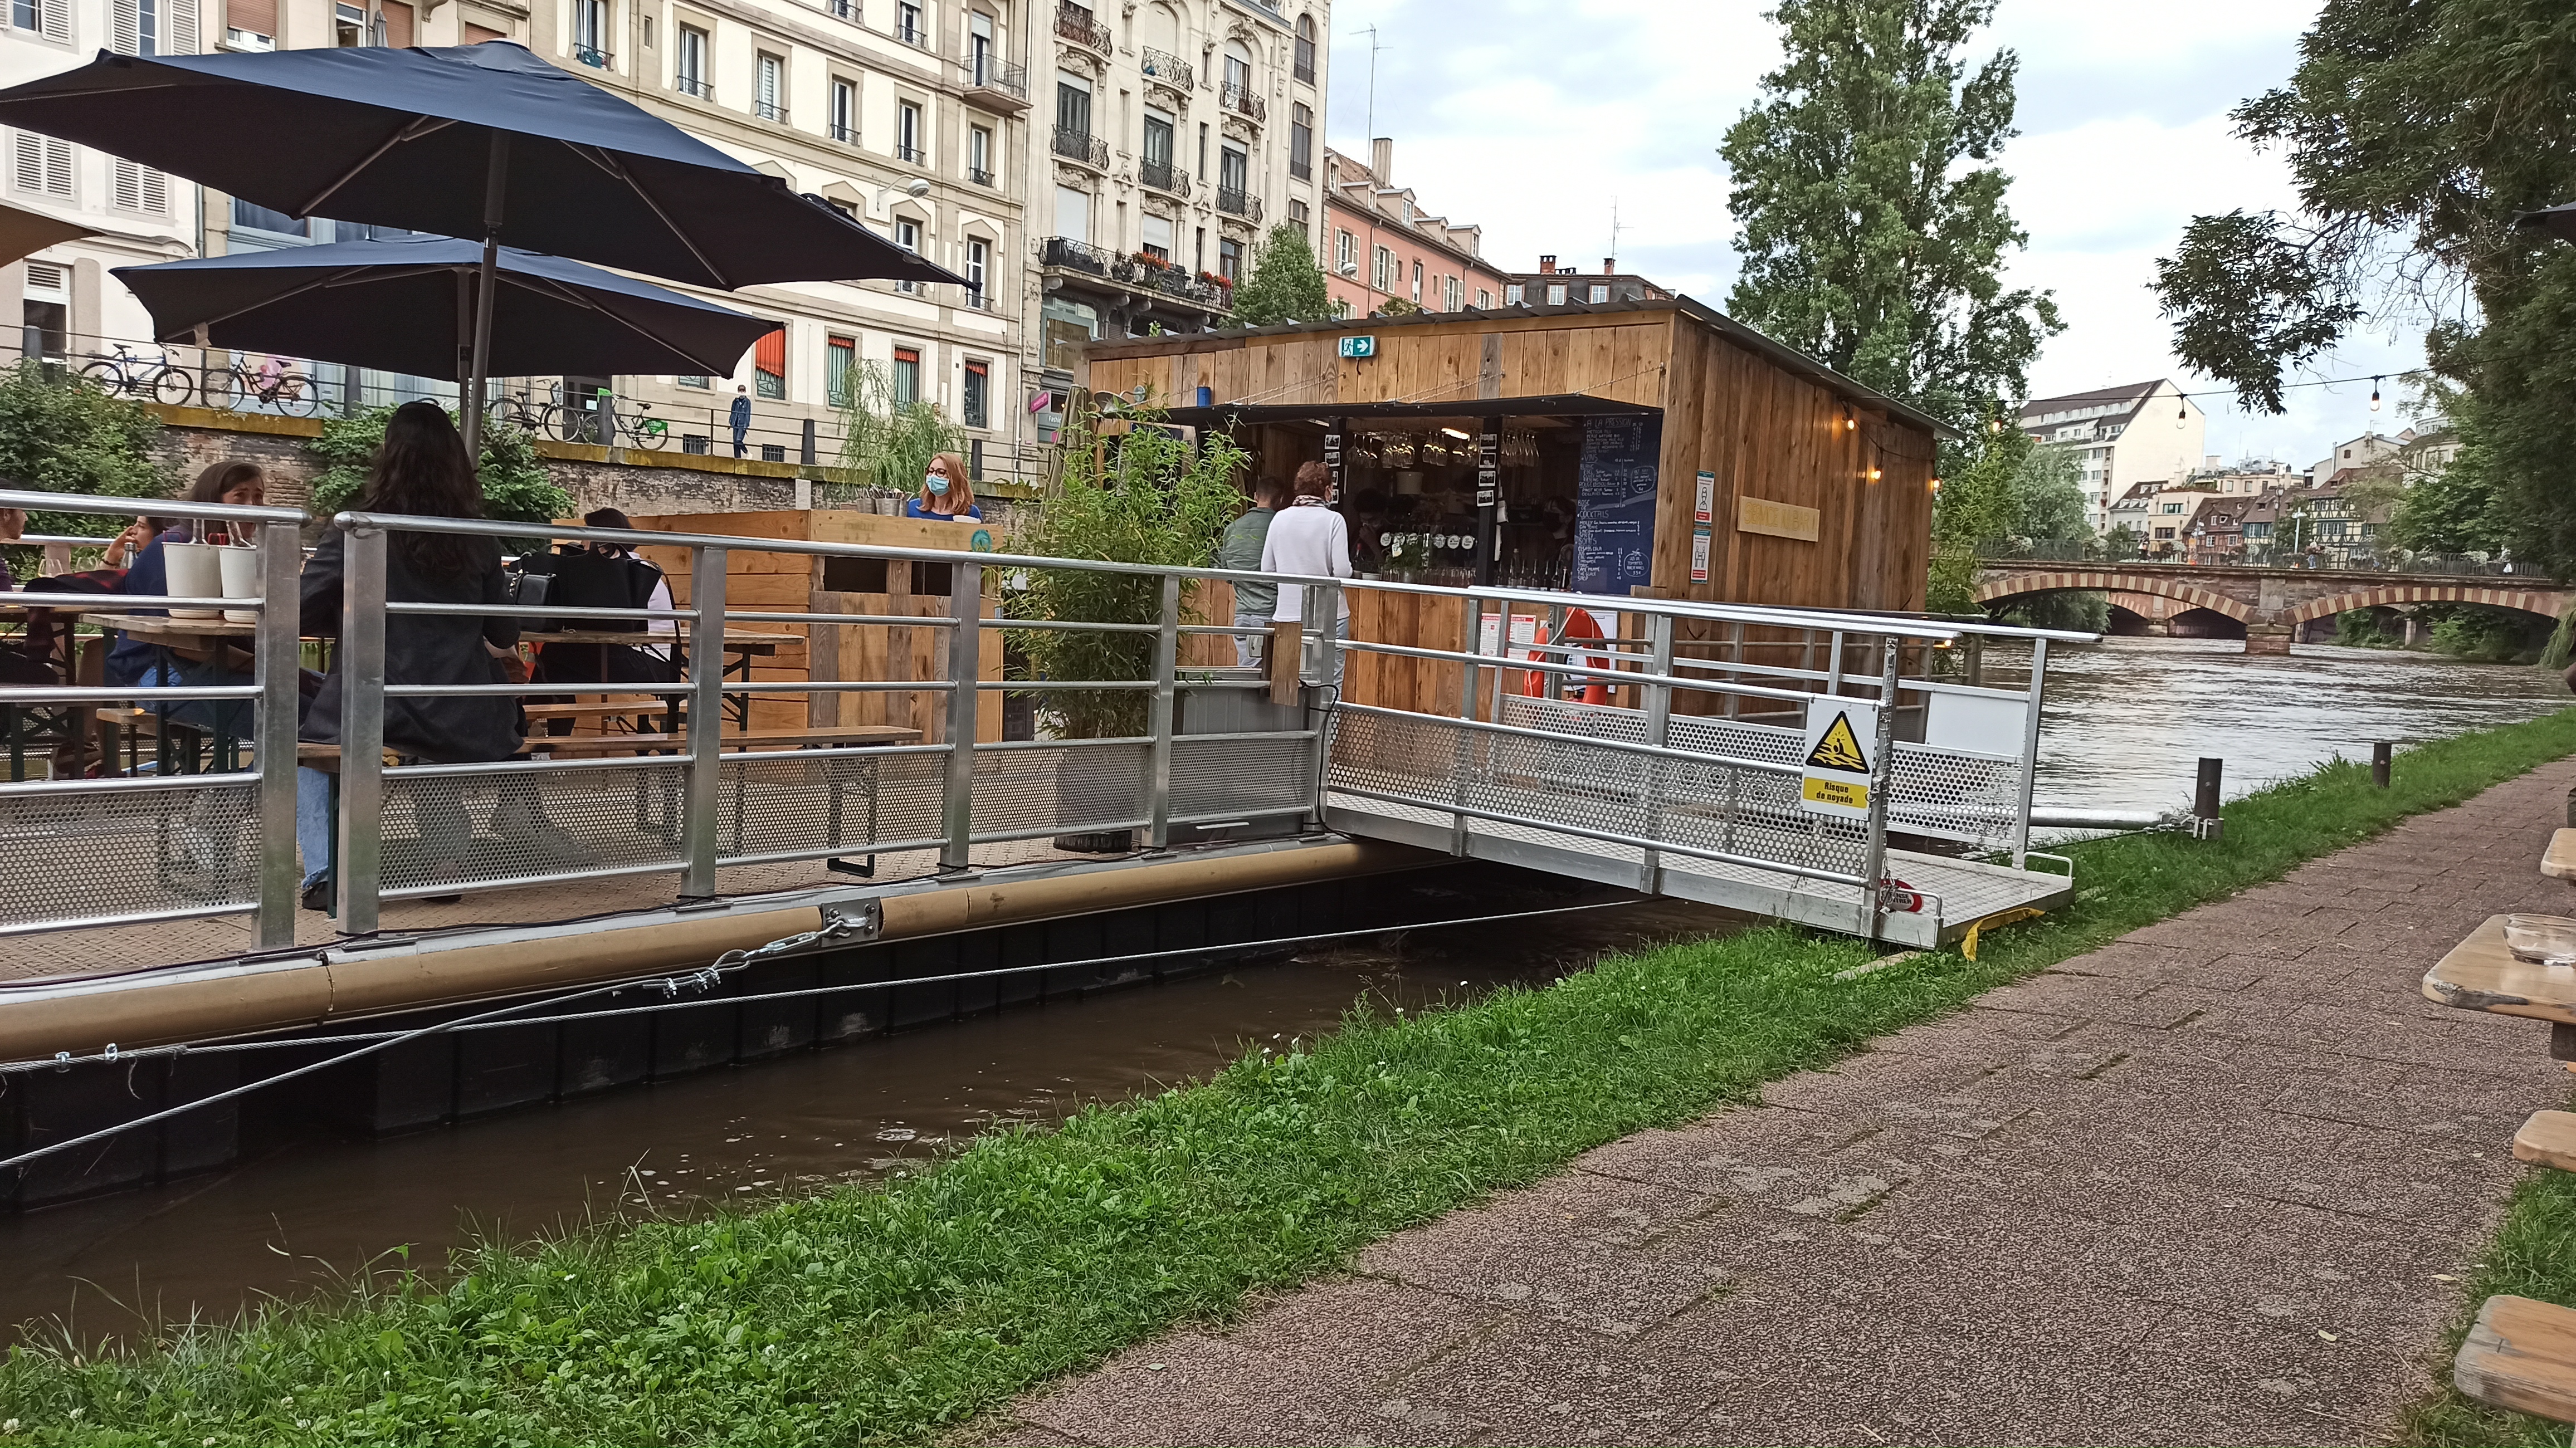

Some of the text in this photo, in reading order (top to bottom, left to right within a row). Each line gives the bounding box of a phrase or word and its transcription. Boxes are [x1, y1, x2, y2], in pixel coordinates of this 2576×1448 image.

[1605, 418, 1632, 427] PRESSION
[1584, 454, 1598, 462] VINS
[1579, 510, 1609, 518] COCKTAILS
[1824, 781, 1849, 794] Risque
[1816, 791, 1853, 804] de noyade
